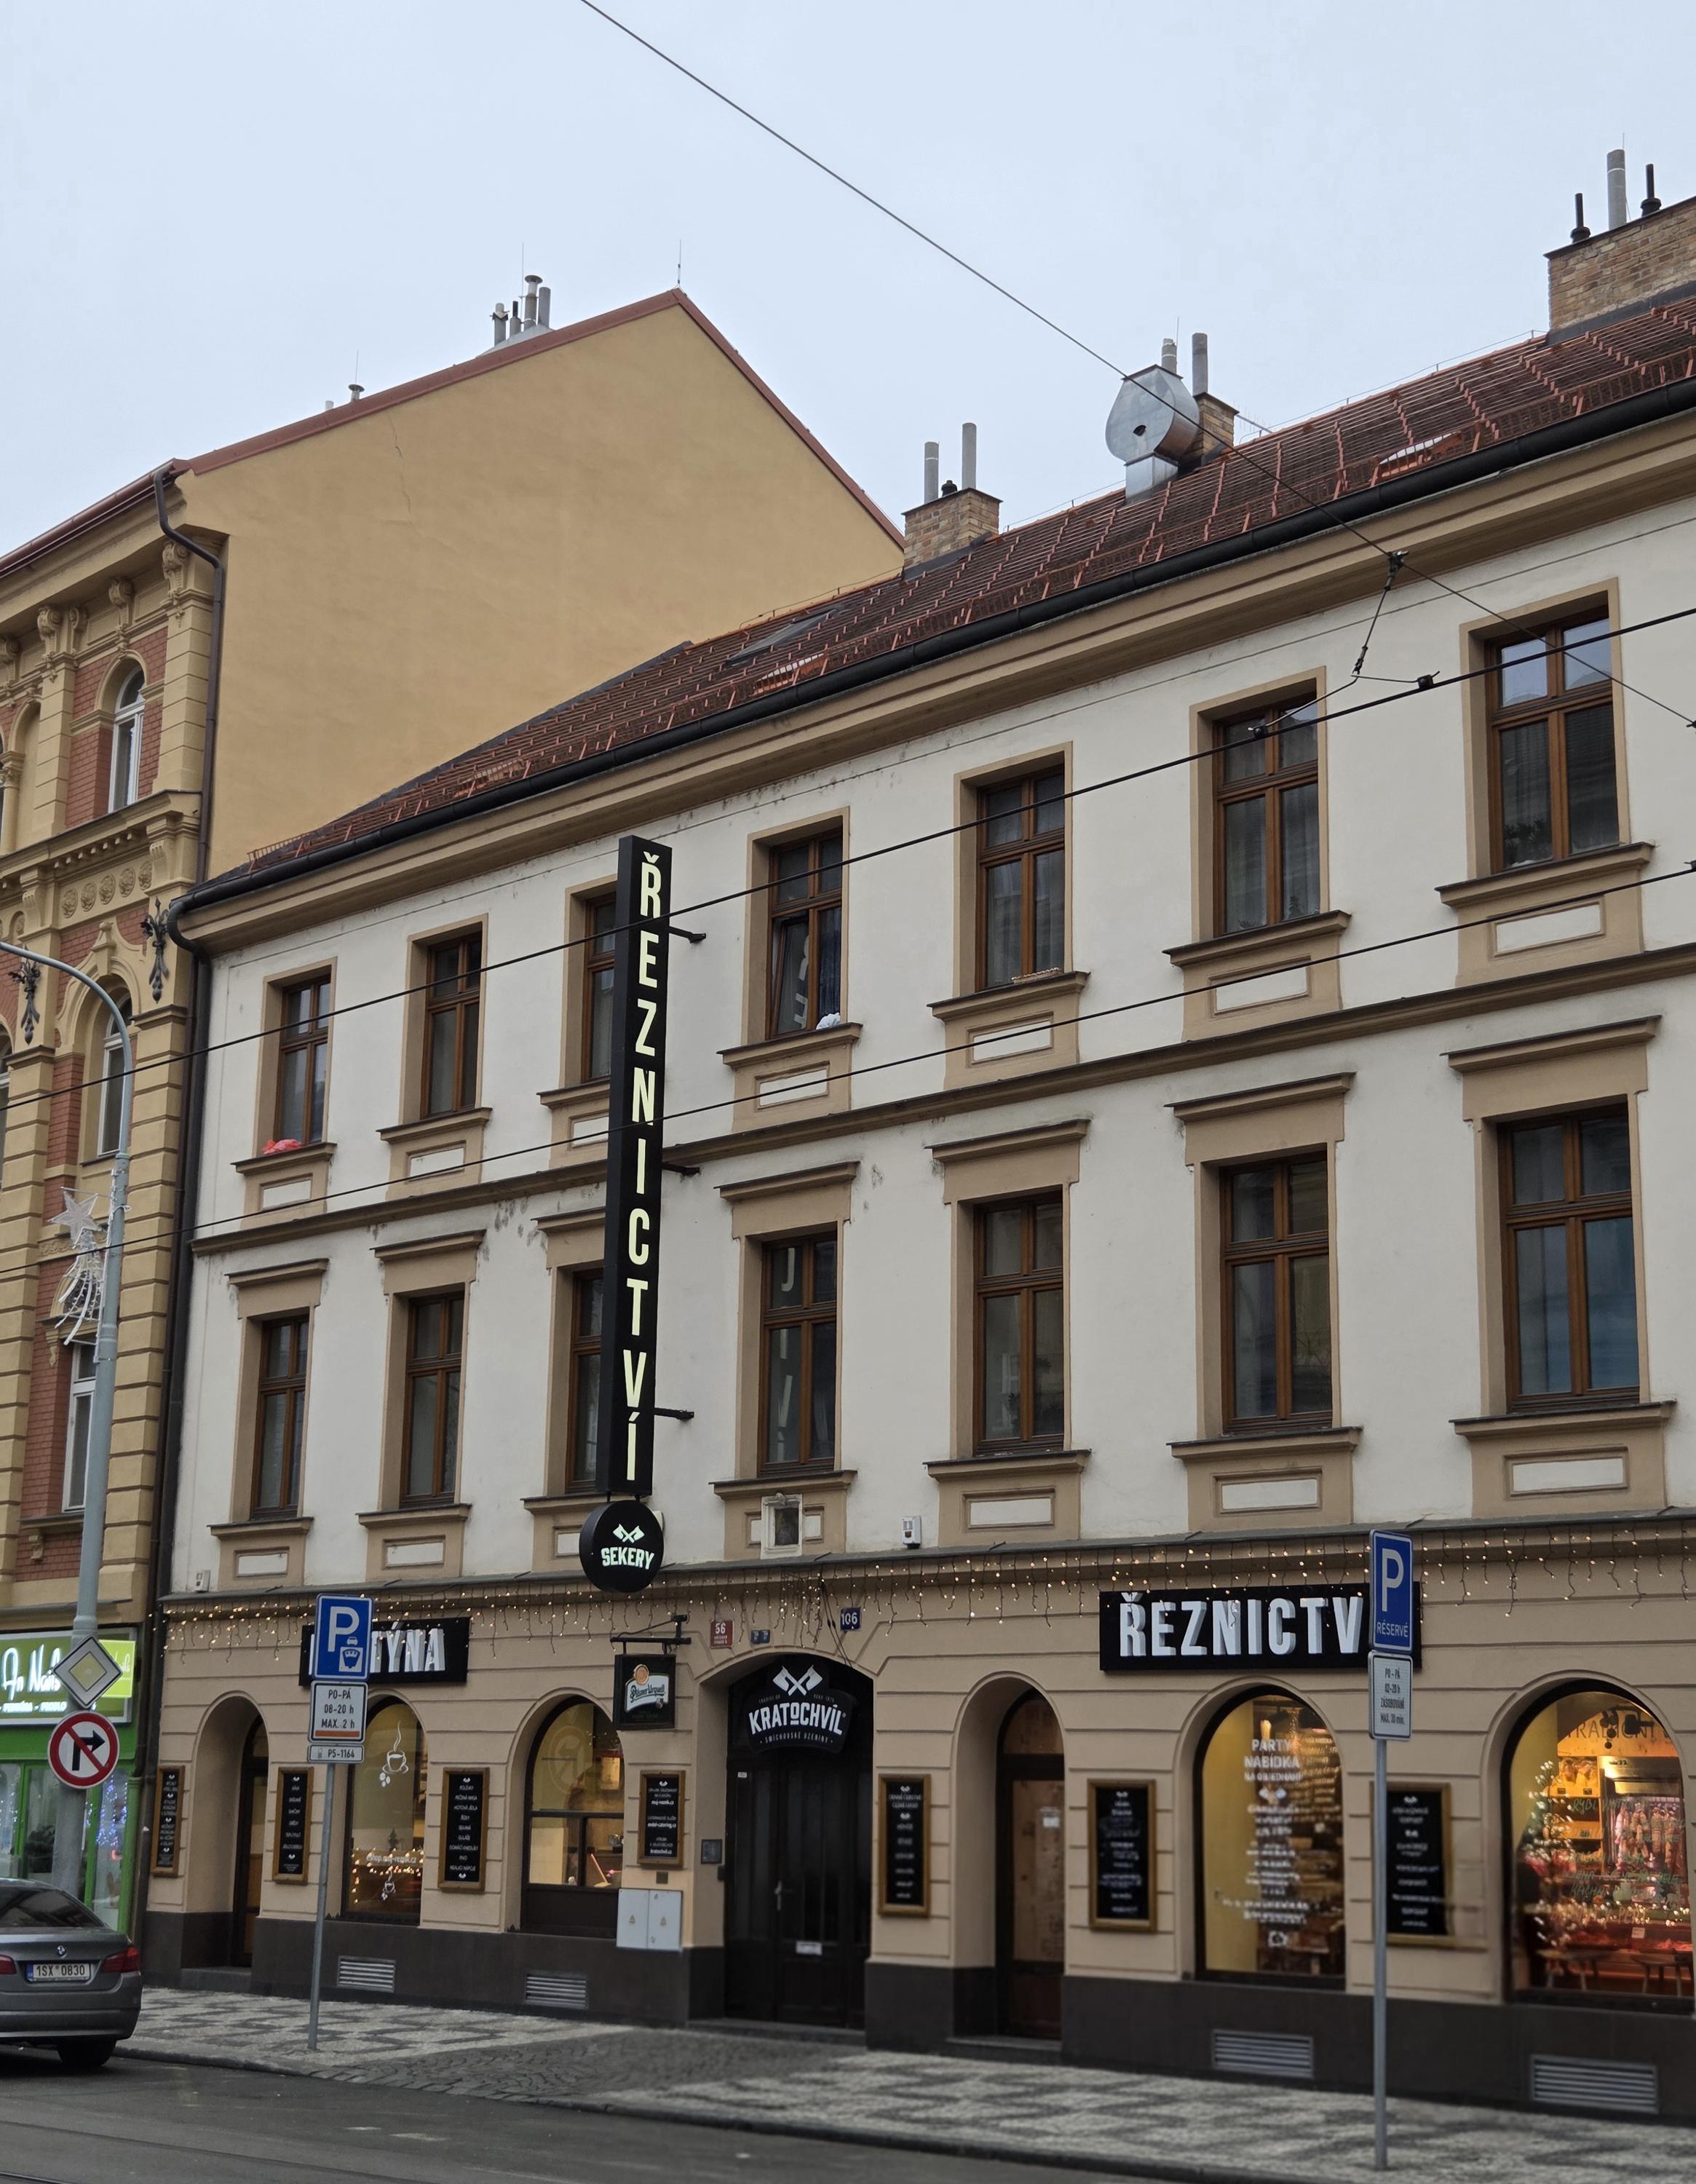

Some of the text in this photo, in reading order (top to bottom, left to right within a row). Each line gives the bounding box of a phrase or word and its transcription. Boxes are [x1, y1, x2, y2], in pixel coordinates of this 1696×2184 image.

[623, 854, 660, 1481] ŘEZNICTVÍ
[601, 1546, 654, 1570] SEKERY
[1382, 1548, 1403, 1612] P
[841, 1612, 858, 1625] 106
[1120, 1592, 1363, 1657] ŘEZNICTV
[328, 1606, 360, 1652] P
[715, 1622, 726, 1634] 56
[1376, 1620, 1408, 1638] RÉSERVÉ
[328, 1688, 352, 1699] PO-PÁ
[324, 1704, 354, 1714] 08-20 h
[321, 1718, 355, 1729] MAX. 2 h
[1251, 1738, 1291, 1752] PARTY
[328, 1749, 354, 1758] P5-1164
[1244, 1753, 1300, 1768] NABÍDKA
[36, 1964, 85, 1977] 1SX 0830
